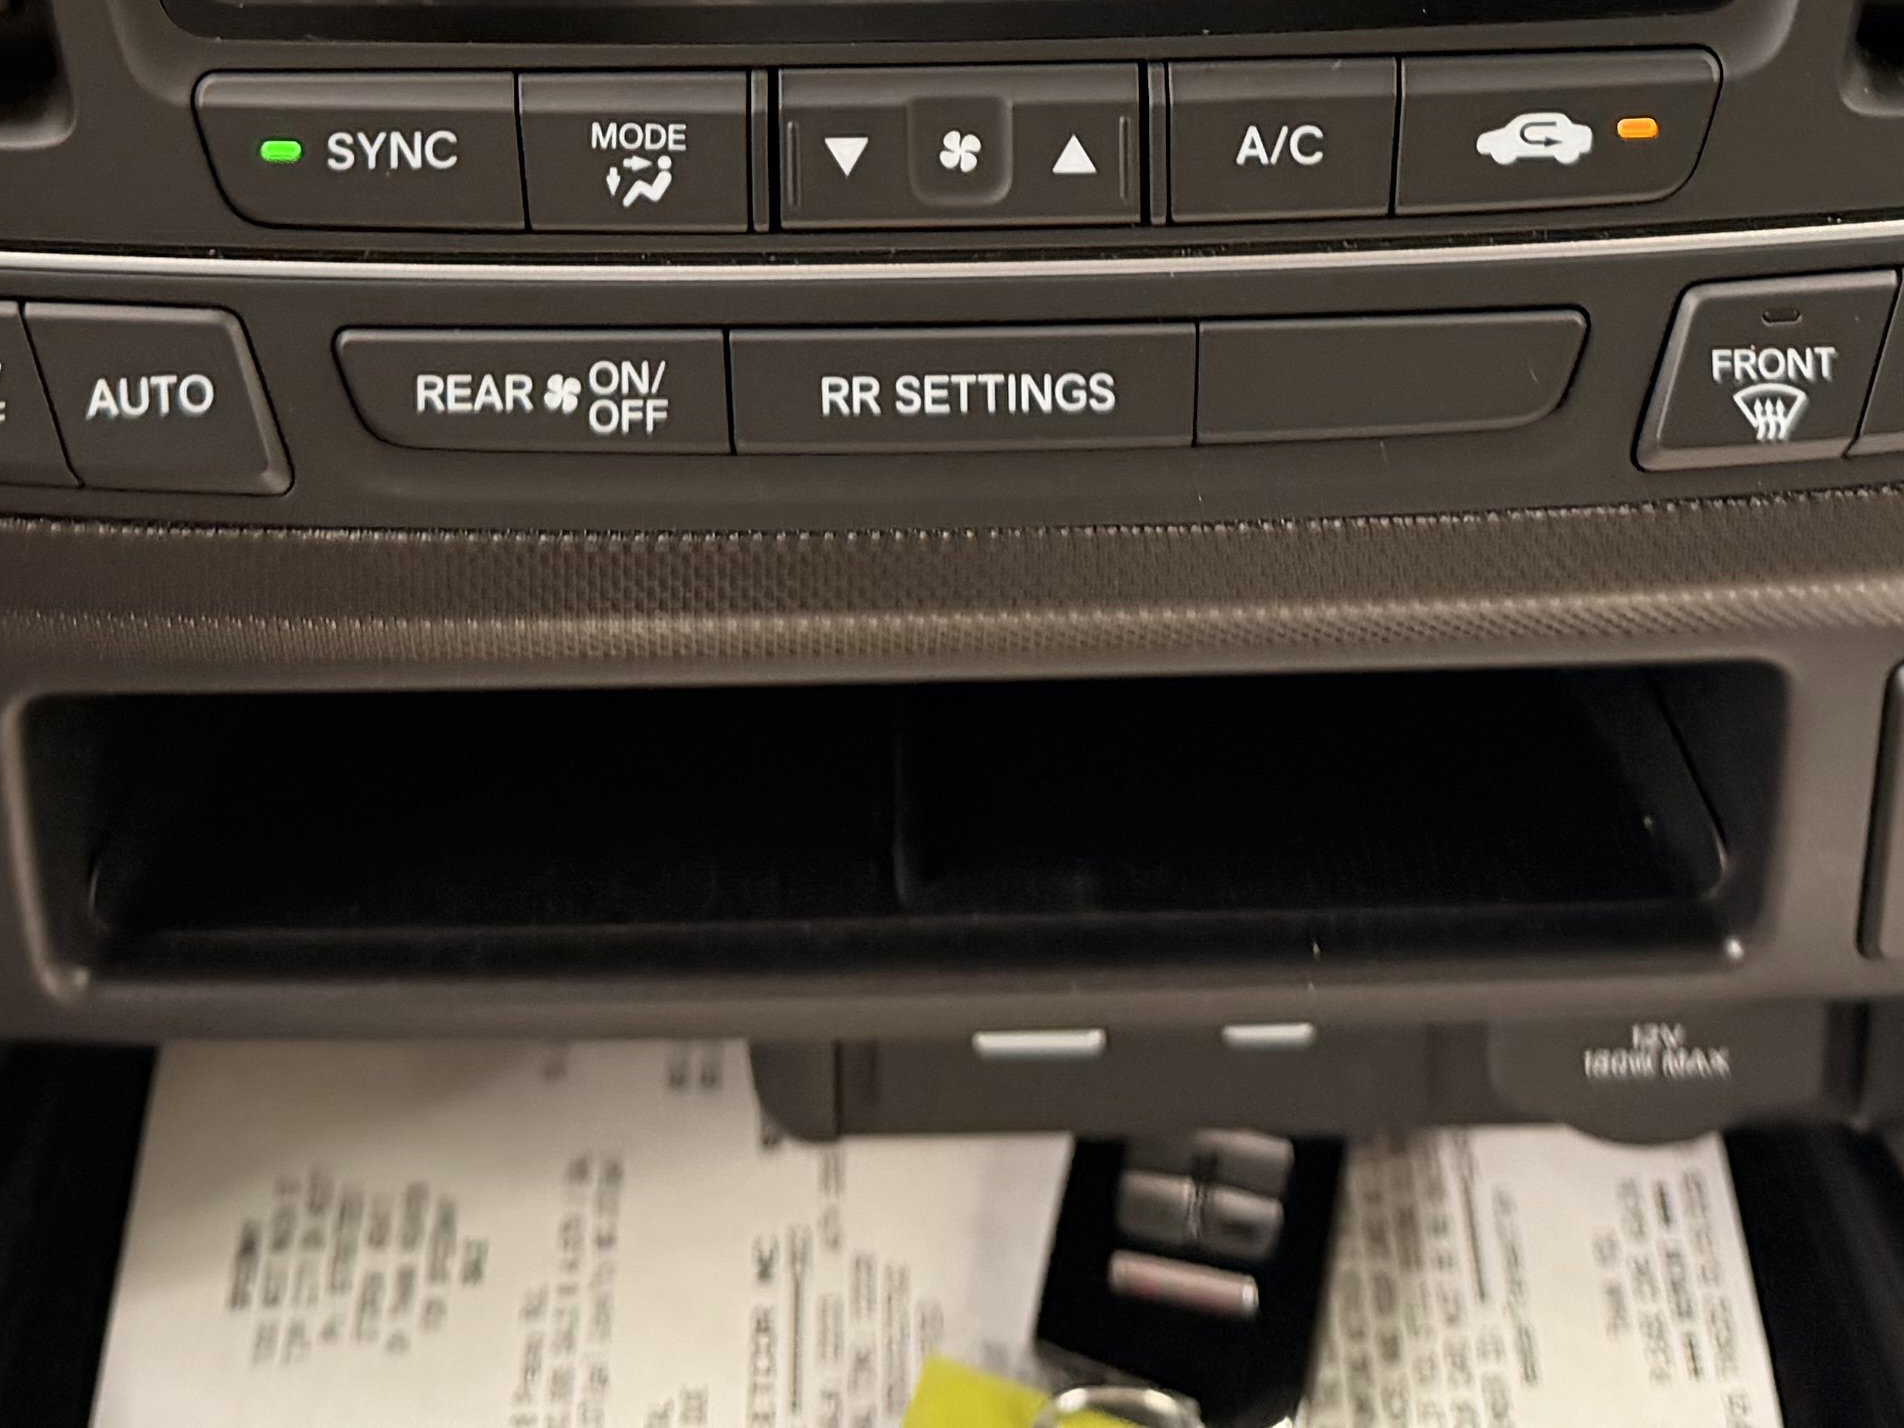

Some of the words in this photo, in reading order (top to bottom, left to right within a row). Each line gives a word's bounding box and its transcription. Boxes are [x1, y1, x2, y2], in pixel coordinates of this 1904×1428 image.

[327, 130, 459, 172] SYNC
[591, 123, 686, 153] MODE
[1238, 124, 1324, 166] A/C
[590, 360, 665, 397] ON/
[1711, 347, 1836, 383] FRONT
[87, 373, 214, 419] AUTO
[416, 375, 533, 414] REAR
[820, 374, 880, 416] RR
[897, 372, 1116, 416] SETTINGS
[590, 398, 668, 436] OFF
